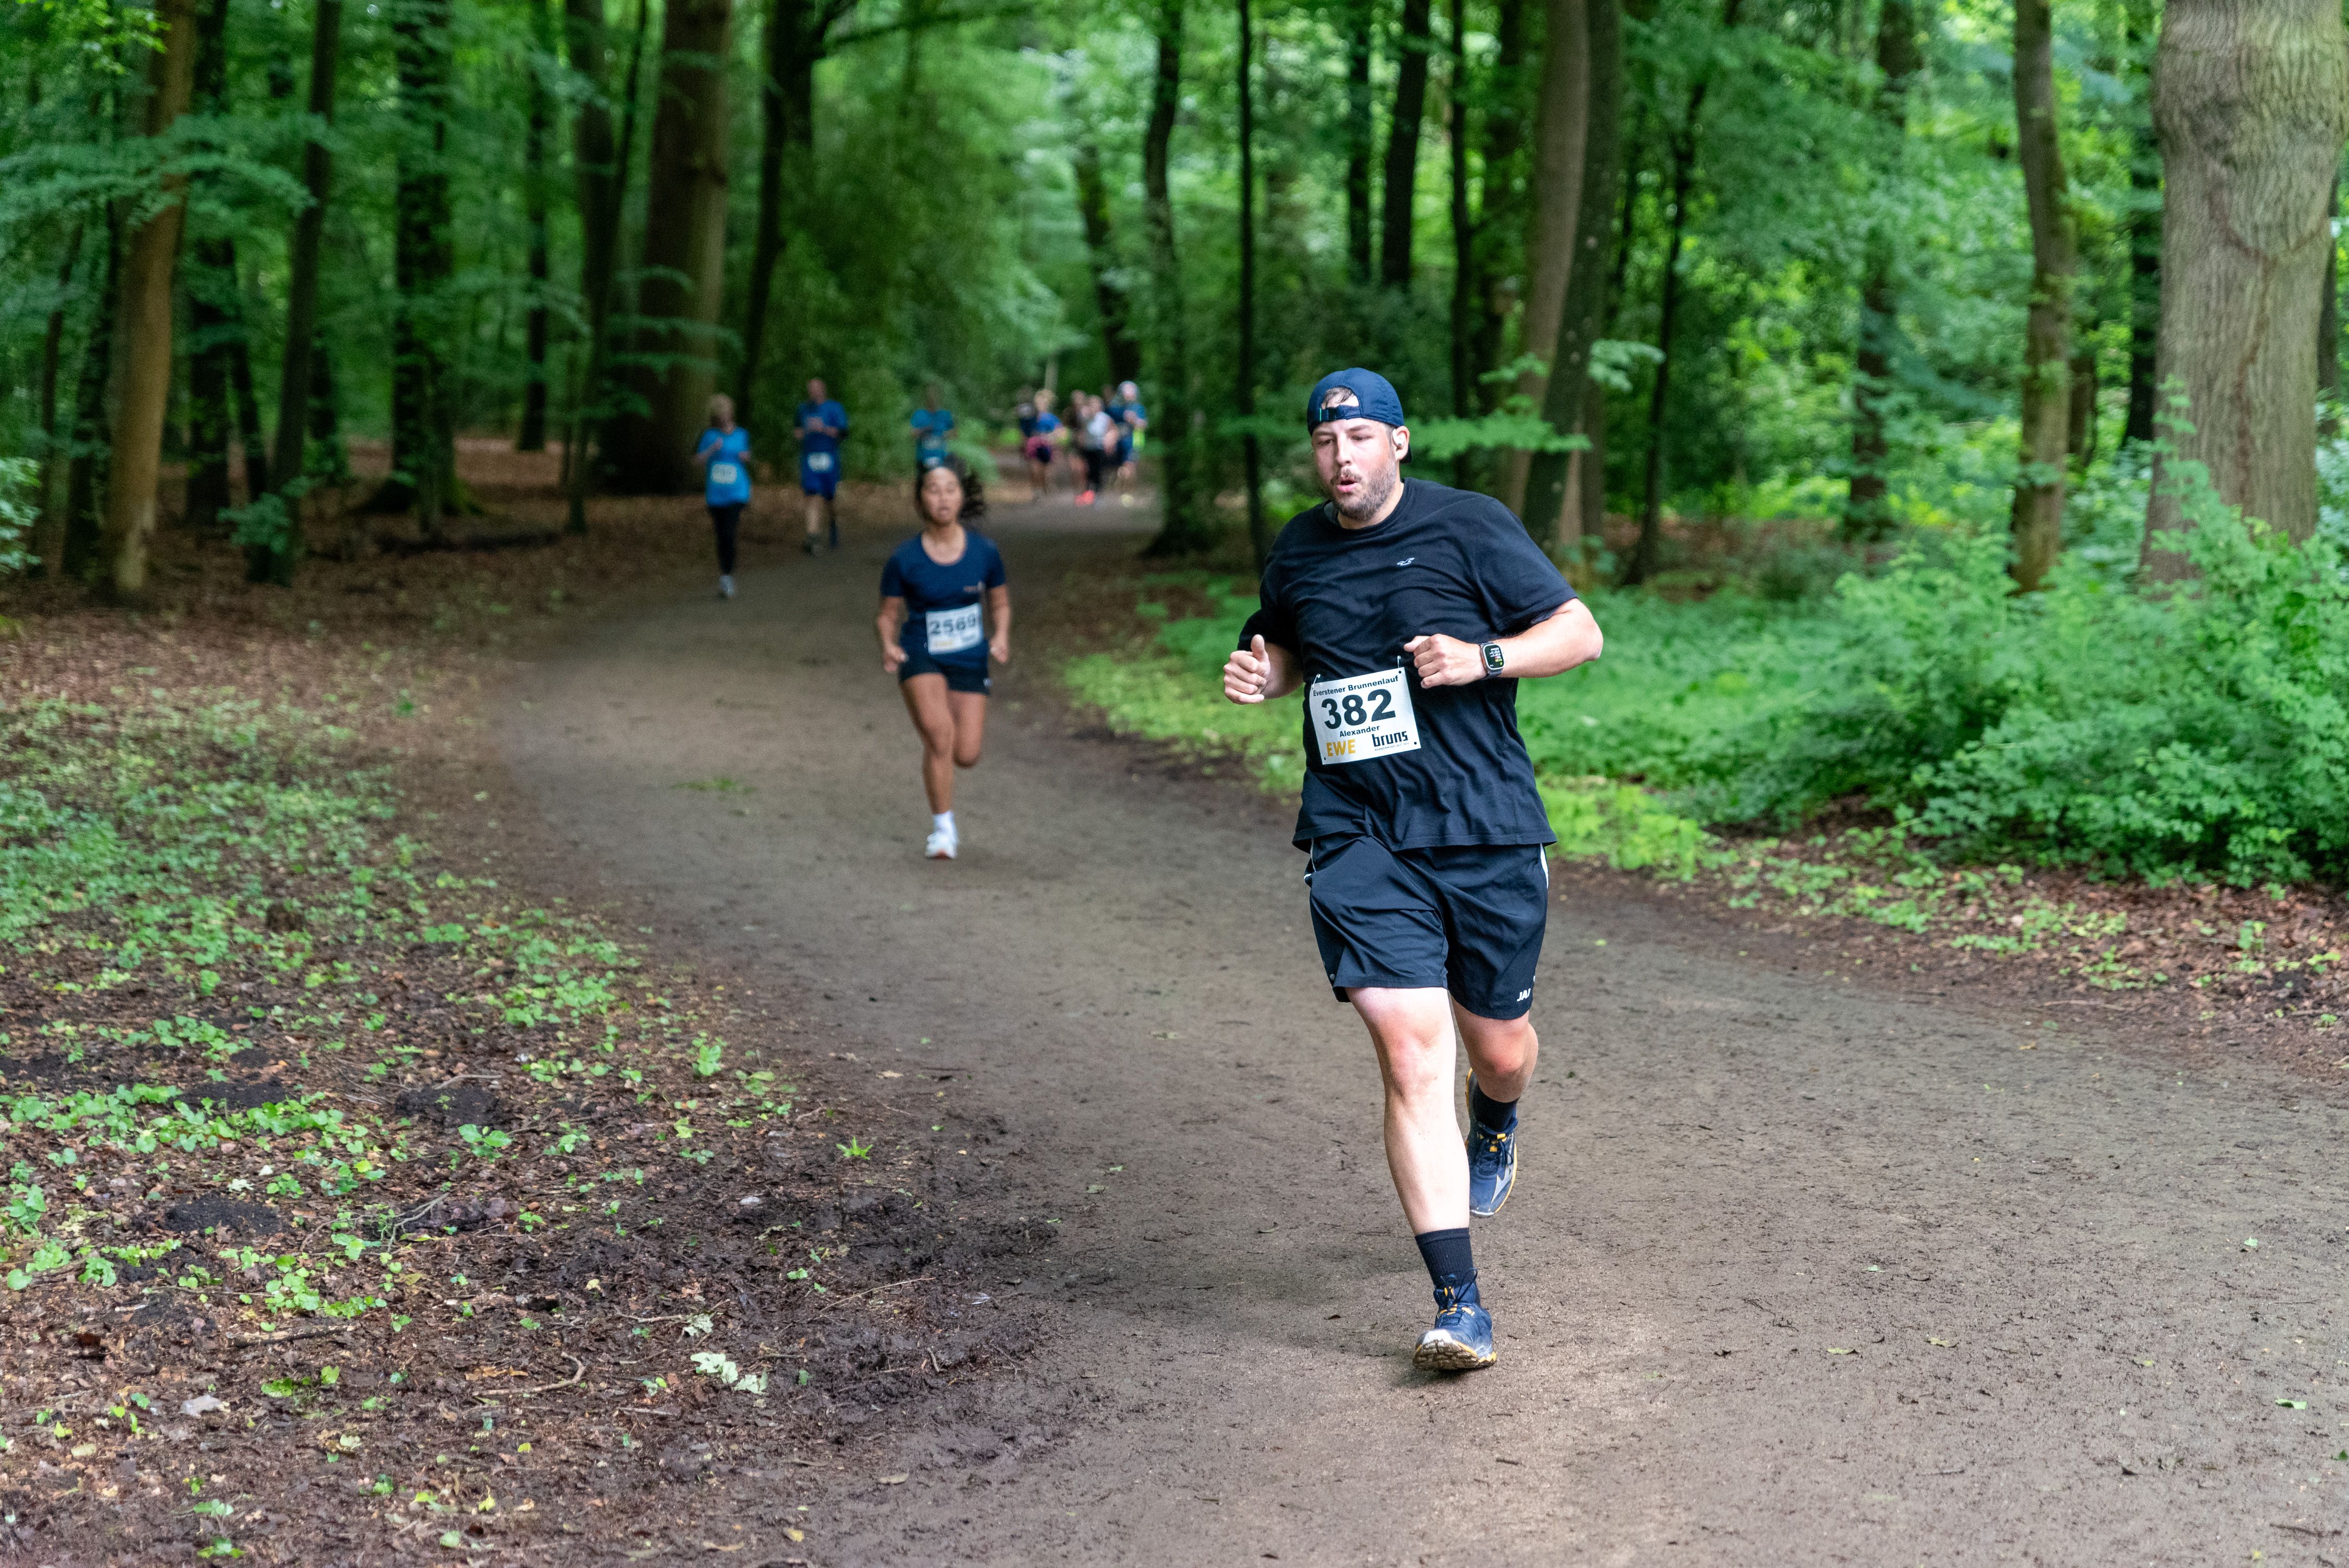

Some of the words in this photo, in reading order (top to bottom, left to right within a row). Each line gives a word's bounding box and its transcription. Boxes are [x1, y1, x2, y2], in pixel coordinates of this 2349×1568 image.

[929, 614, 976, 635] 2569
[1313, 687, 1346, 696] Everstener
[1348, 675, 1398, 691] Brunnenlauf
[1321, 688, 1396, 729] 382
[1339, 726, 1380, 737] Alexander
[1371, 731, 1408, 747] bruns
[1326, 739, 1356, 756] EWE
